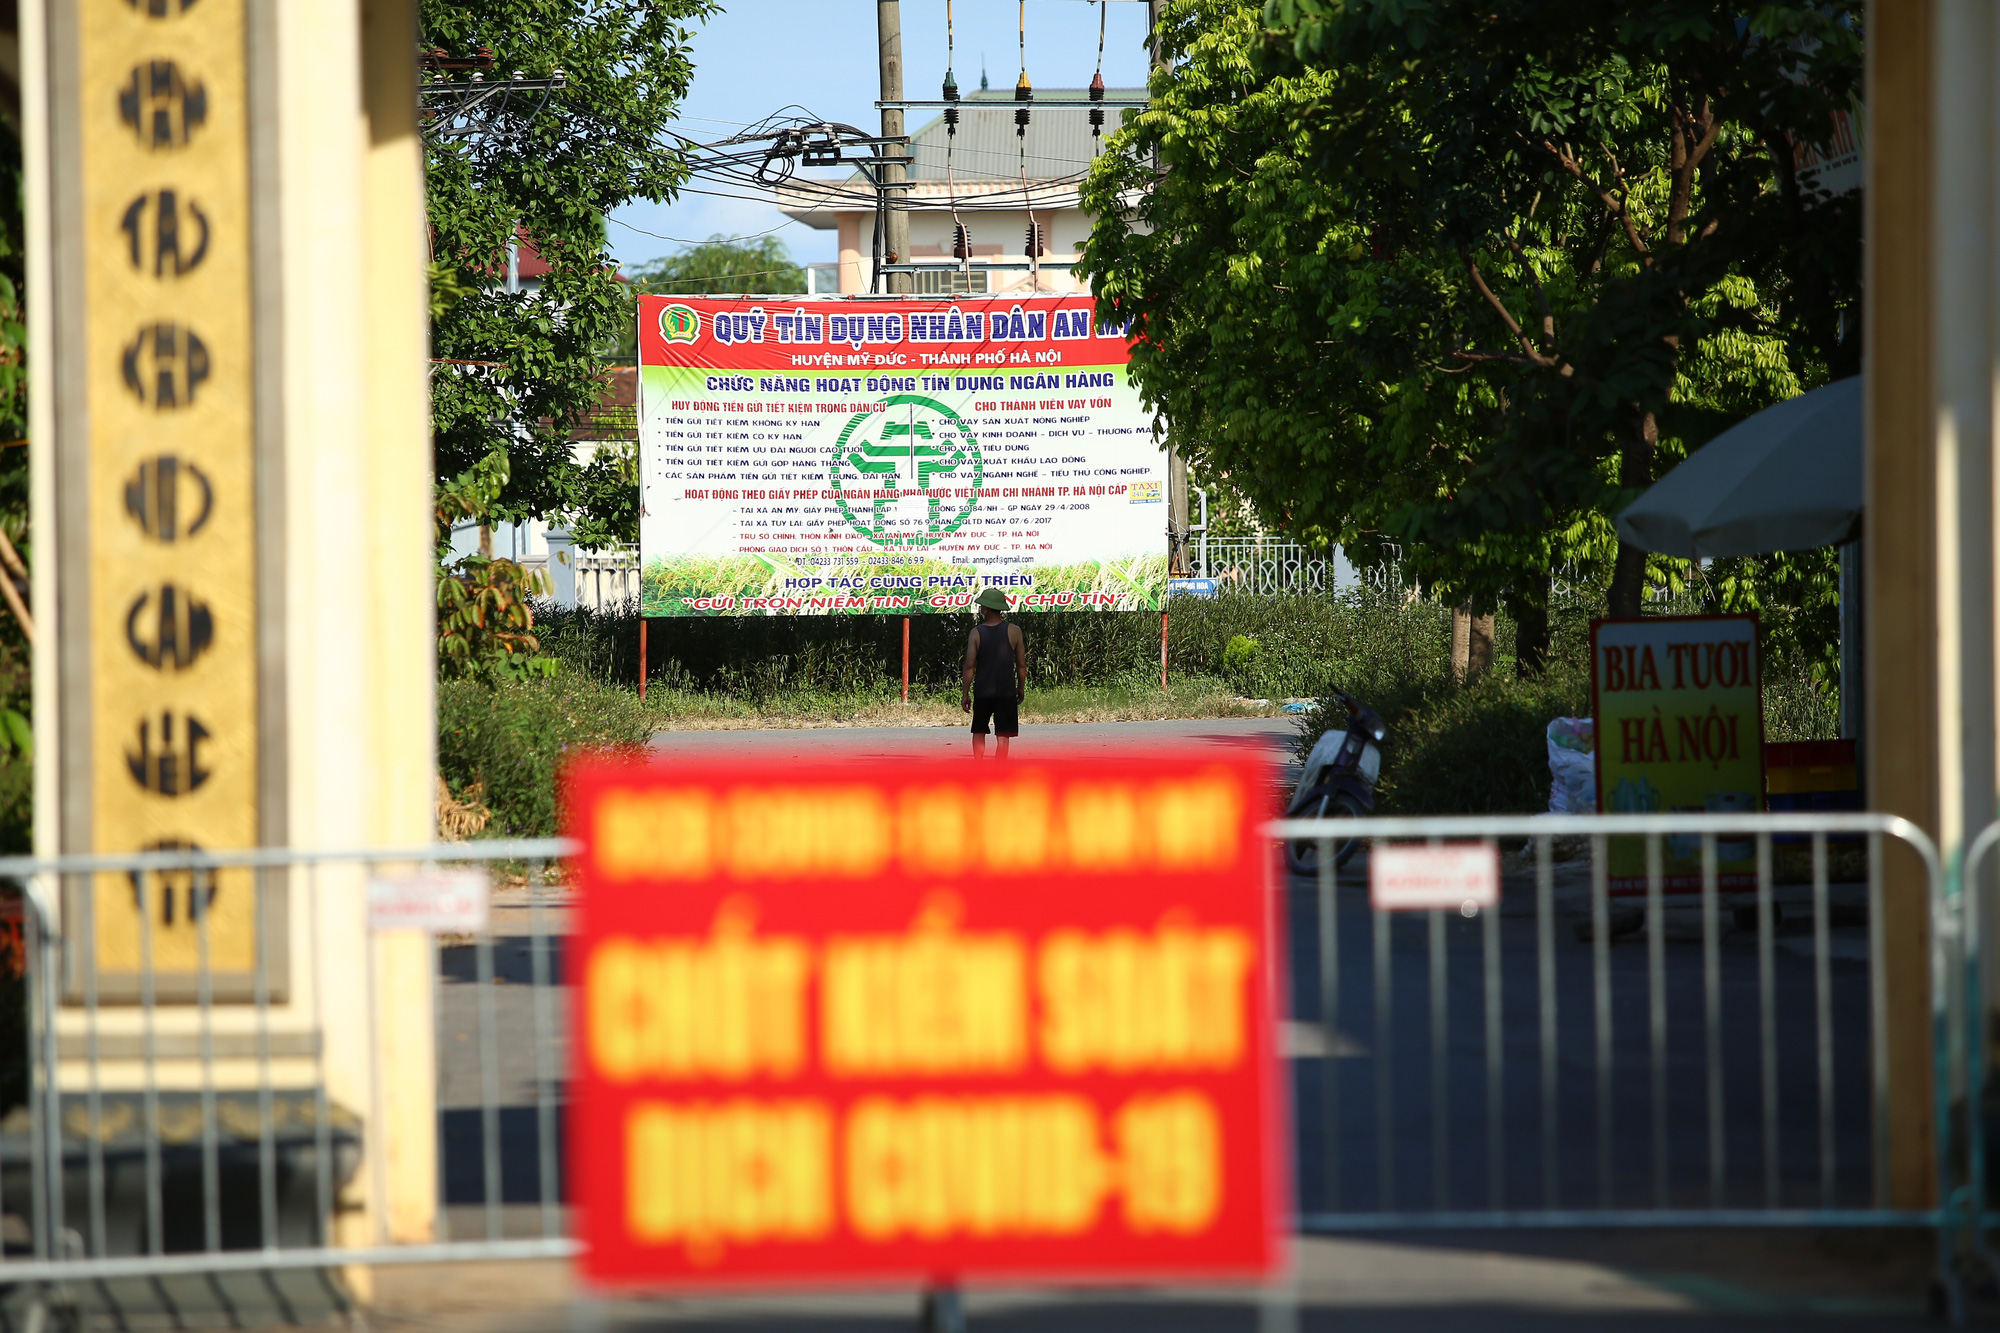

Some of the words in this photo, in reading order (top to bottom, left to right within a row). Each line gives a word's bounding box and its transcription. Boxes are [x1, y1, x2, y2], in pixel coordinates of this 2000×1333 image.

[715, 310, 765, 342] QUỸ
[775, 310, 821, 341] TÍN
[831, 315, 901, 348] DỤNG
[910, 308, 982, 340] NHÂN
[992, 307, 1044, 339] DÂN
[1054, 312, 1088, 337] AN
[791, 352, 843, 369] HUYỆN
[847, 351, 870, 366] MỸ
[874, 351, 907, 366] ĐỨC
[920, 350, 971, 365] THÀNH
[975, 348, 1006, 364] PHỐ
[1010, 349, 1031, 364] HÀ
[1035, 348, 1062, 366] NỘI
[706, 374, 754, 392] CHỨC
[760, 375, 810, 392] NĂNG
[816, 378, 861, 395] HOẠT
[867, 375, 916, 395] ĐỘNG
[922, 374, 950, 391] TÍN
[956, 376, 1004, 394] DỤNG
[1010, 372, 1060, 390] NGÂN
[1066, 371, 1114, 389] HÀNG
[672, 401, 690, 410] HUY
[815, 403, 847, 413] TRONG
[873, 403, 887, 412] CƯ
[975, 402, 996, 411] CHO
[1068, 399, 1086, 409] VAY
[742, 490, 765, 499] THEO
[978, 488, 999, 497] NAM
[1003, 488, 1018, 497] CHI
[1058, 487, 1070, 496] TP.
[1131, 482, 1158, 490] TAXI
[785, 577, 822, 592] HỢP
[828, 573, 864, 588] TÁC
[869, 573, 922, 588] CÙNG
[928, 572, 976, 587] PHÁT
[981, 569, 1033, 586] TRIỂN
[742, 597, 802, 612] TRỌN
[874, 596, 909, 608] TIN
[1025, 592, 1076, 606] CHỮ
[1602, 644, 1662, 692] BIA
[1619, 704, 1671, 764] HÀ
[1676, 704, 1741, 771] NỘI
